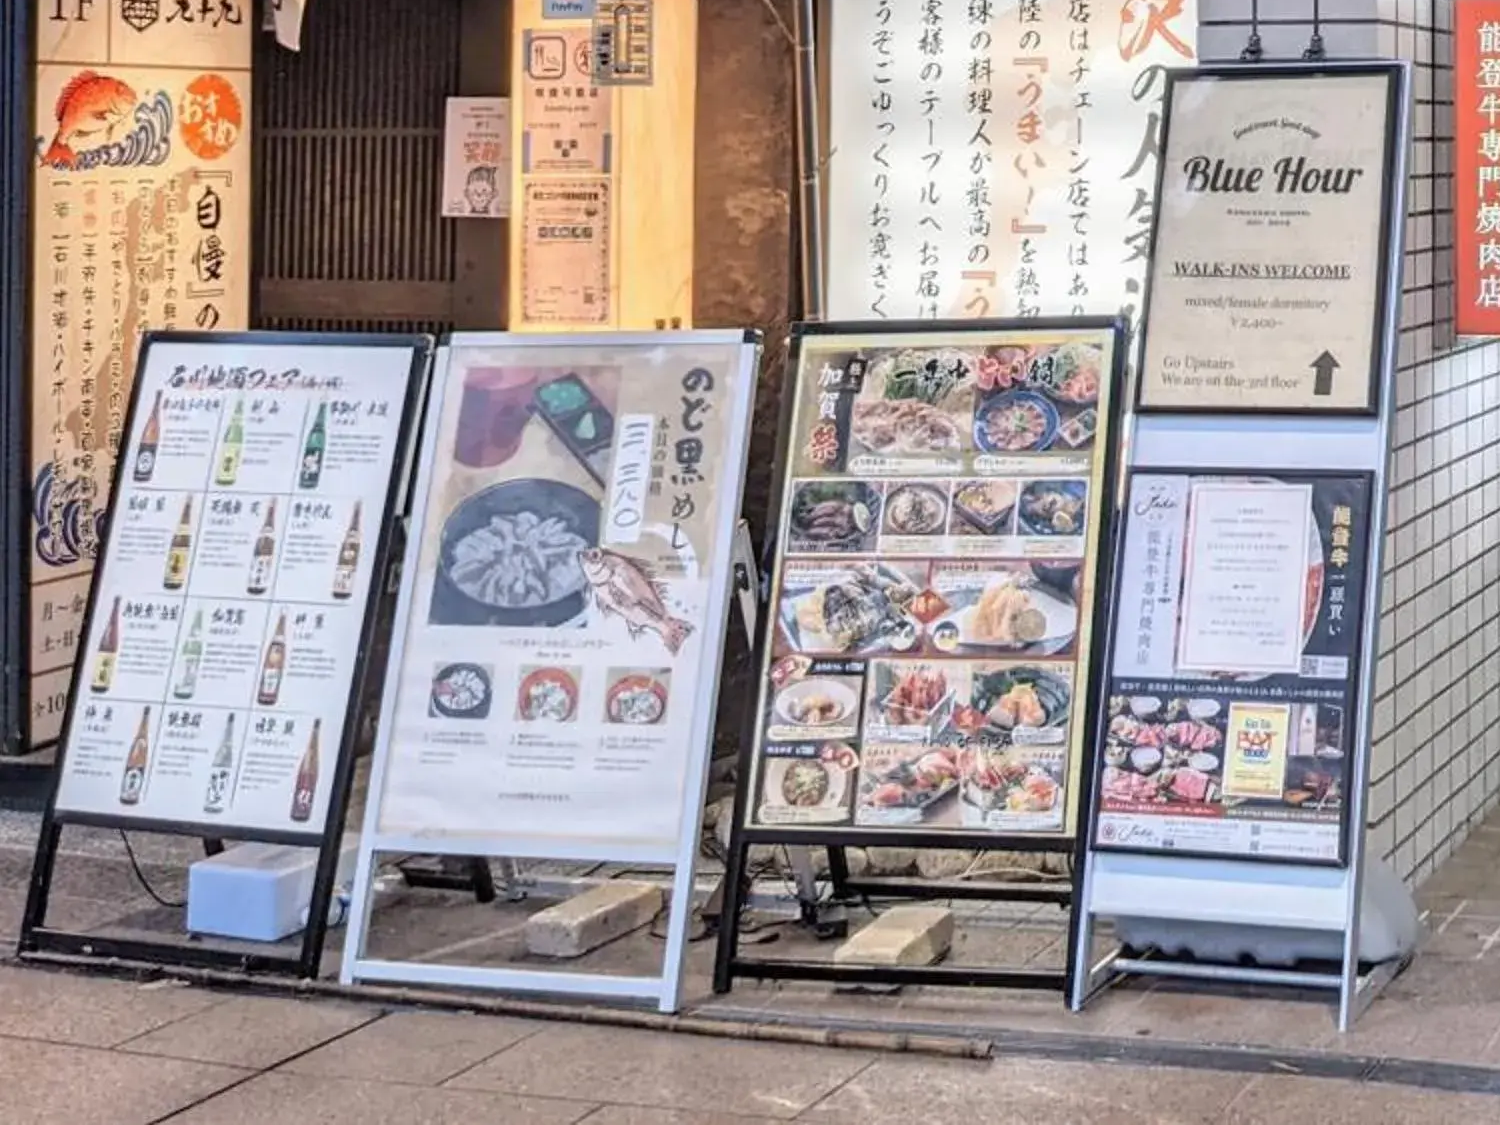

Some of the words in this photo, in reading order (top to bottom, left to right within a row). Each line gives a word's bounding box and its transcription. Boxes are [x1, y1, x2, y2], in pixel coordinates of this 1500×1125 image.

[1184, 155, 1265, 194] Blue
[1273, 155, 1364, 195] Hour
[1174, 261, 1261, 277] WALK-INS
[1262, 263, 1350, 279] WELCOME
[1185, 295, 1268, 310] mixed/female
[1270, 296, 1331, 312] dormitory
[1163, 356, 1180, 369] Go
[1184, 356, 1235, 372] Upstairs
[1162, 372, 1182, 386] We
[1184, 376, 1203, 386] are
[1206, 376, 1221, 387] on
[1223, 375, 1244, 387] the
[1270, 375, 1300, 388] floor
[672, 367, 714, 549] のど黒めし
